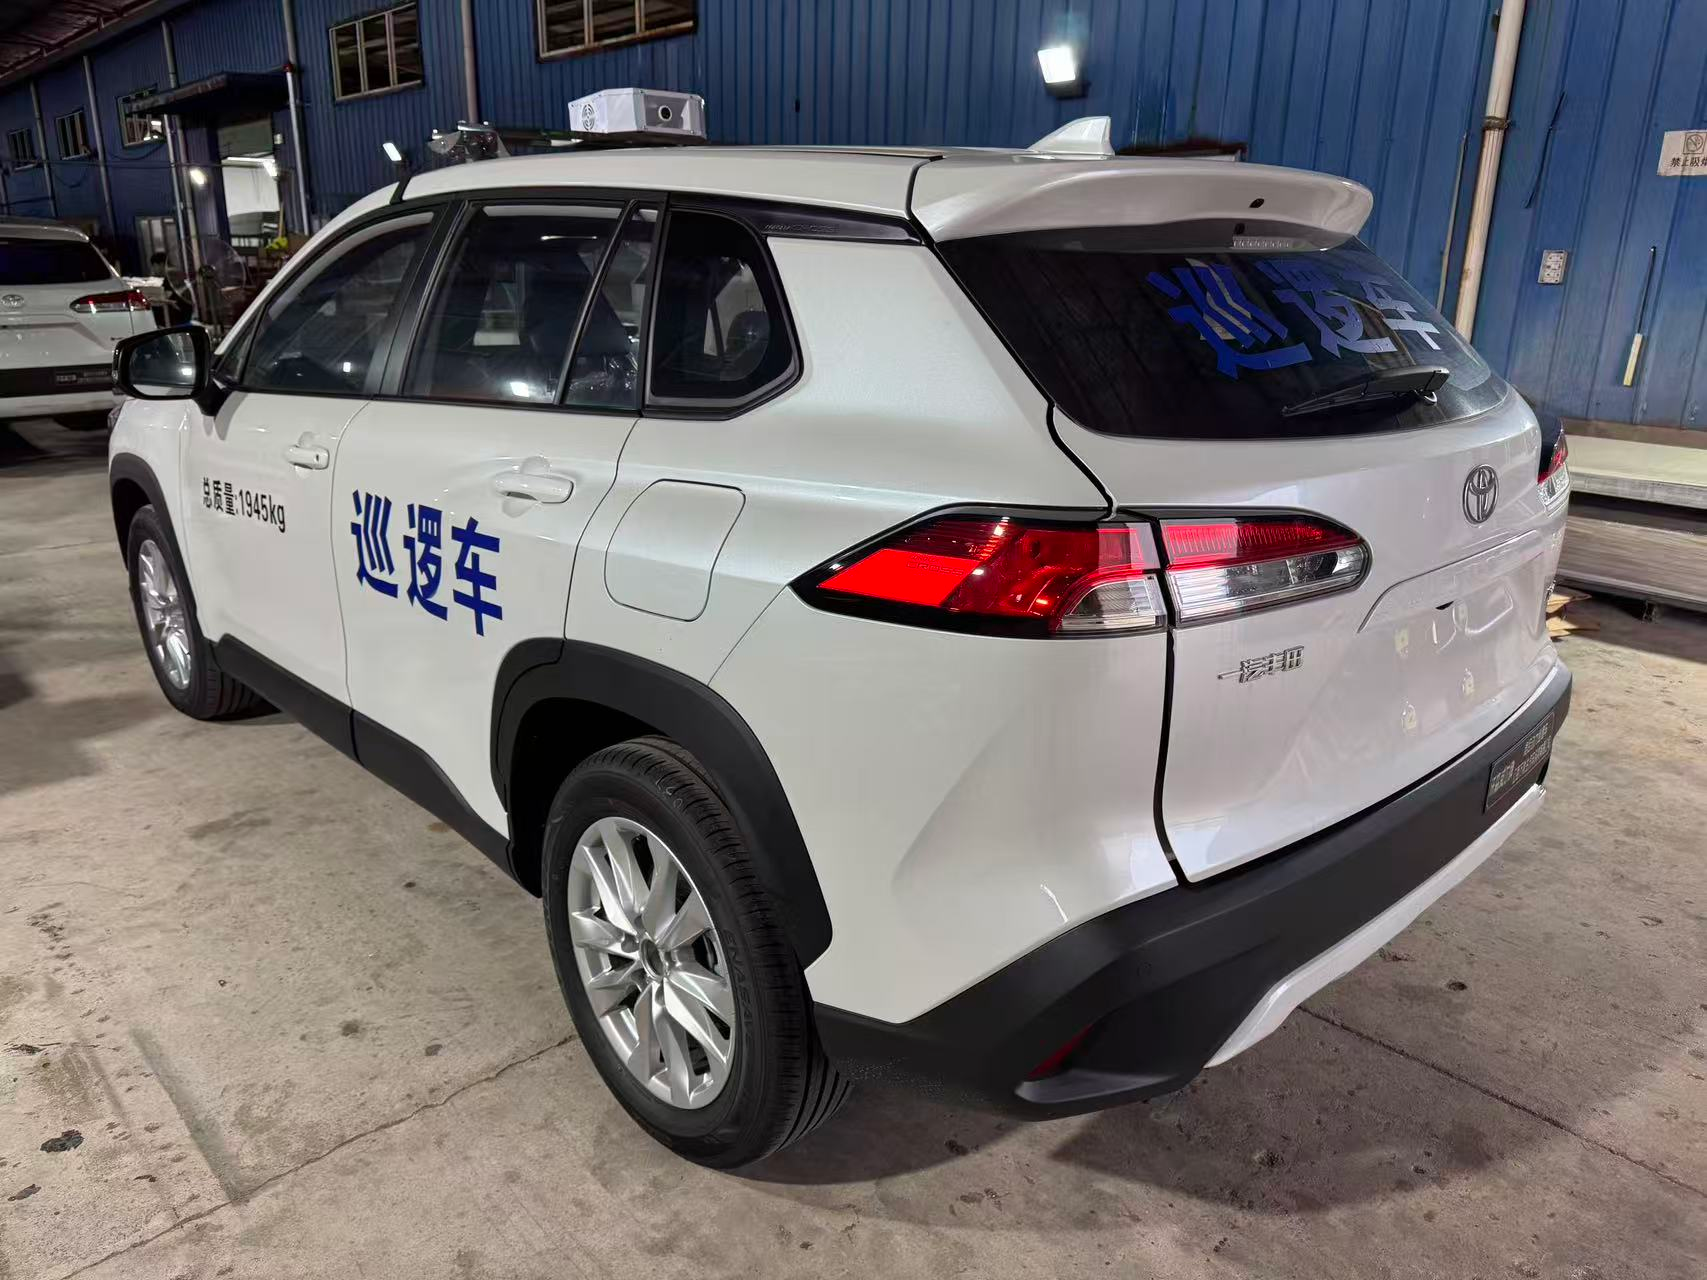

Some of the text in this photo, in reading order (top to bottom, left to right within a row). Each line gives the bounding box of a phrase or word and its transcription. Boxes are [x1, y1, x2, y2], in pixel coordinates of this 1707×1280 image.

[1146, 259, 1440, 380] 巡逻车
[202, 476, 286, 534] 总质量:1945kg
[350, 489, 503, 637] 巡逻车
[1217, 644, 1304, 683] 一汽丰田
